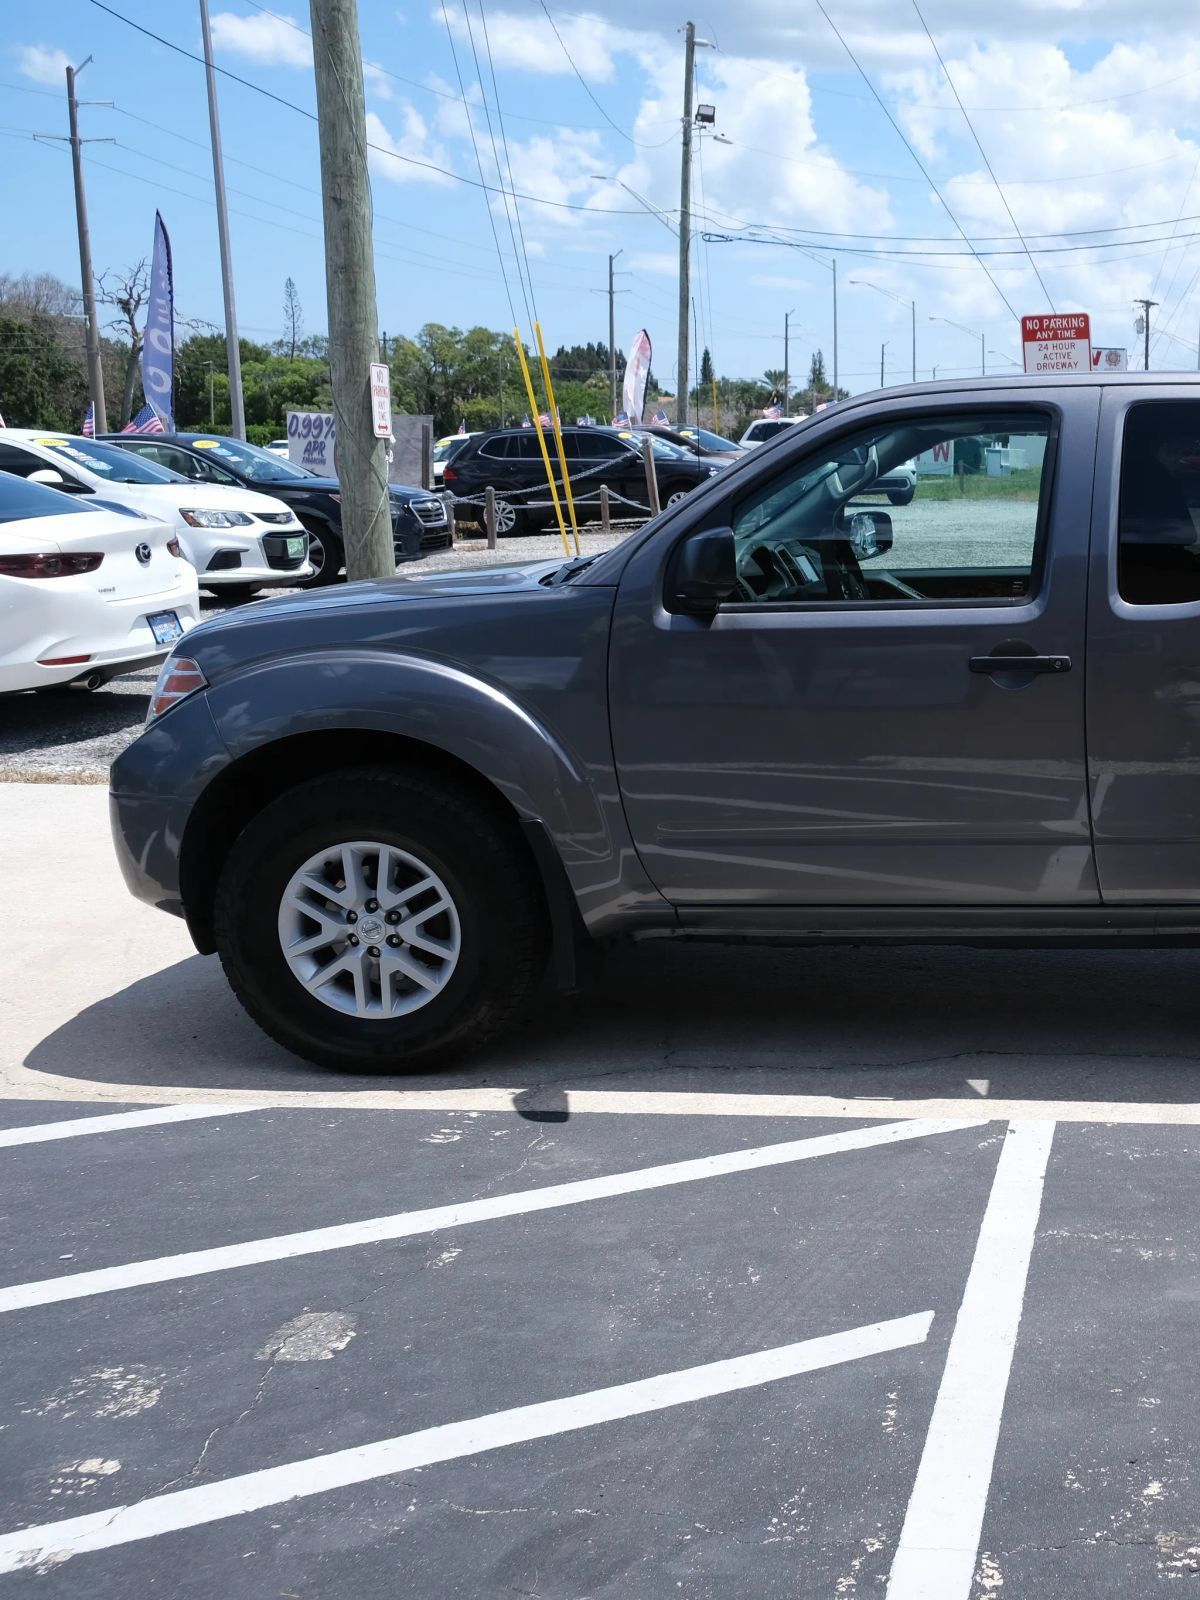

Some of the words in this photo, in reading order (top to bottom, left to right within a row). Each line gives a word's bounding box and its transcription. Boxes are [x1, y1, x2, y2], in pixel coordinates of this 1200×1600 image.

[1026, 319, 1040, 330] NO
[1043, 317, 1085, 329] PARKING
[1036, 330, 1054, 340] ANY
[1057, 329, 1077, 338] TIME
[1038, 343, 1049, 351] 24
[1052, 342, 1076, 350] HOUR
[1043, 352, 1073, 361] ACTIVE
[1036, 361, 1079, 371] DRIVEWAY
[288, 414, 336, 440] 0.99%
[303, 440, 326, 457] APR
